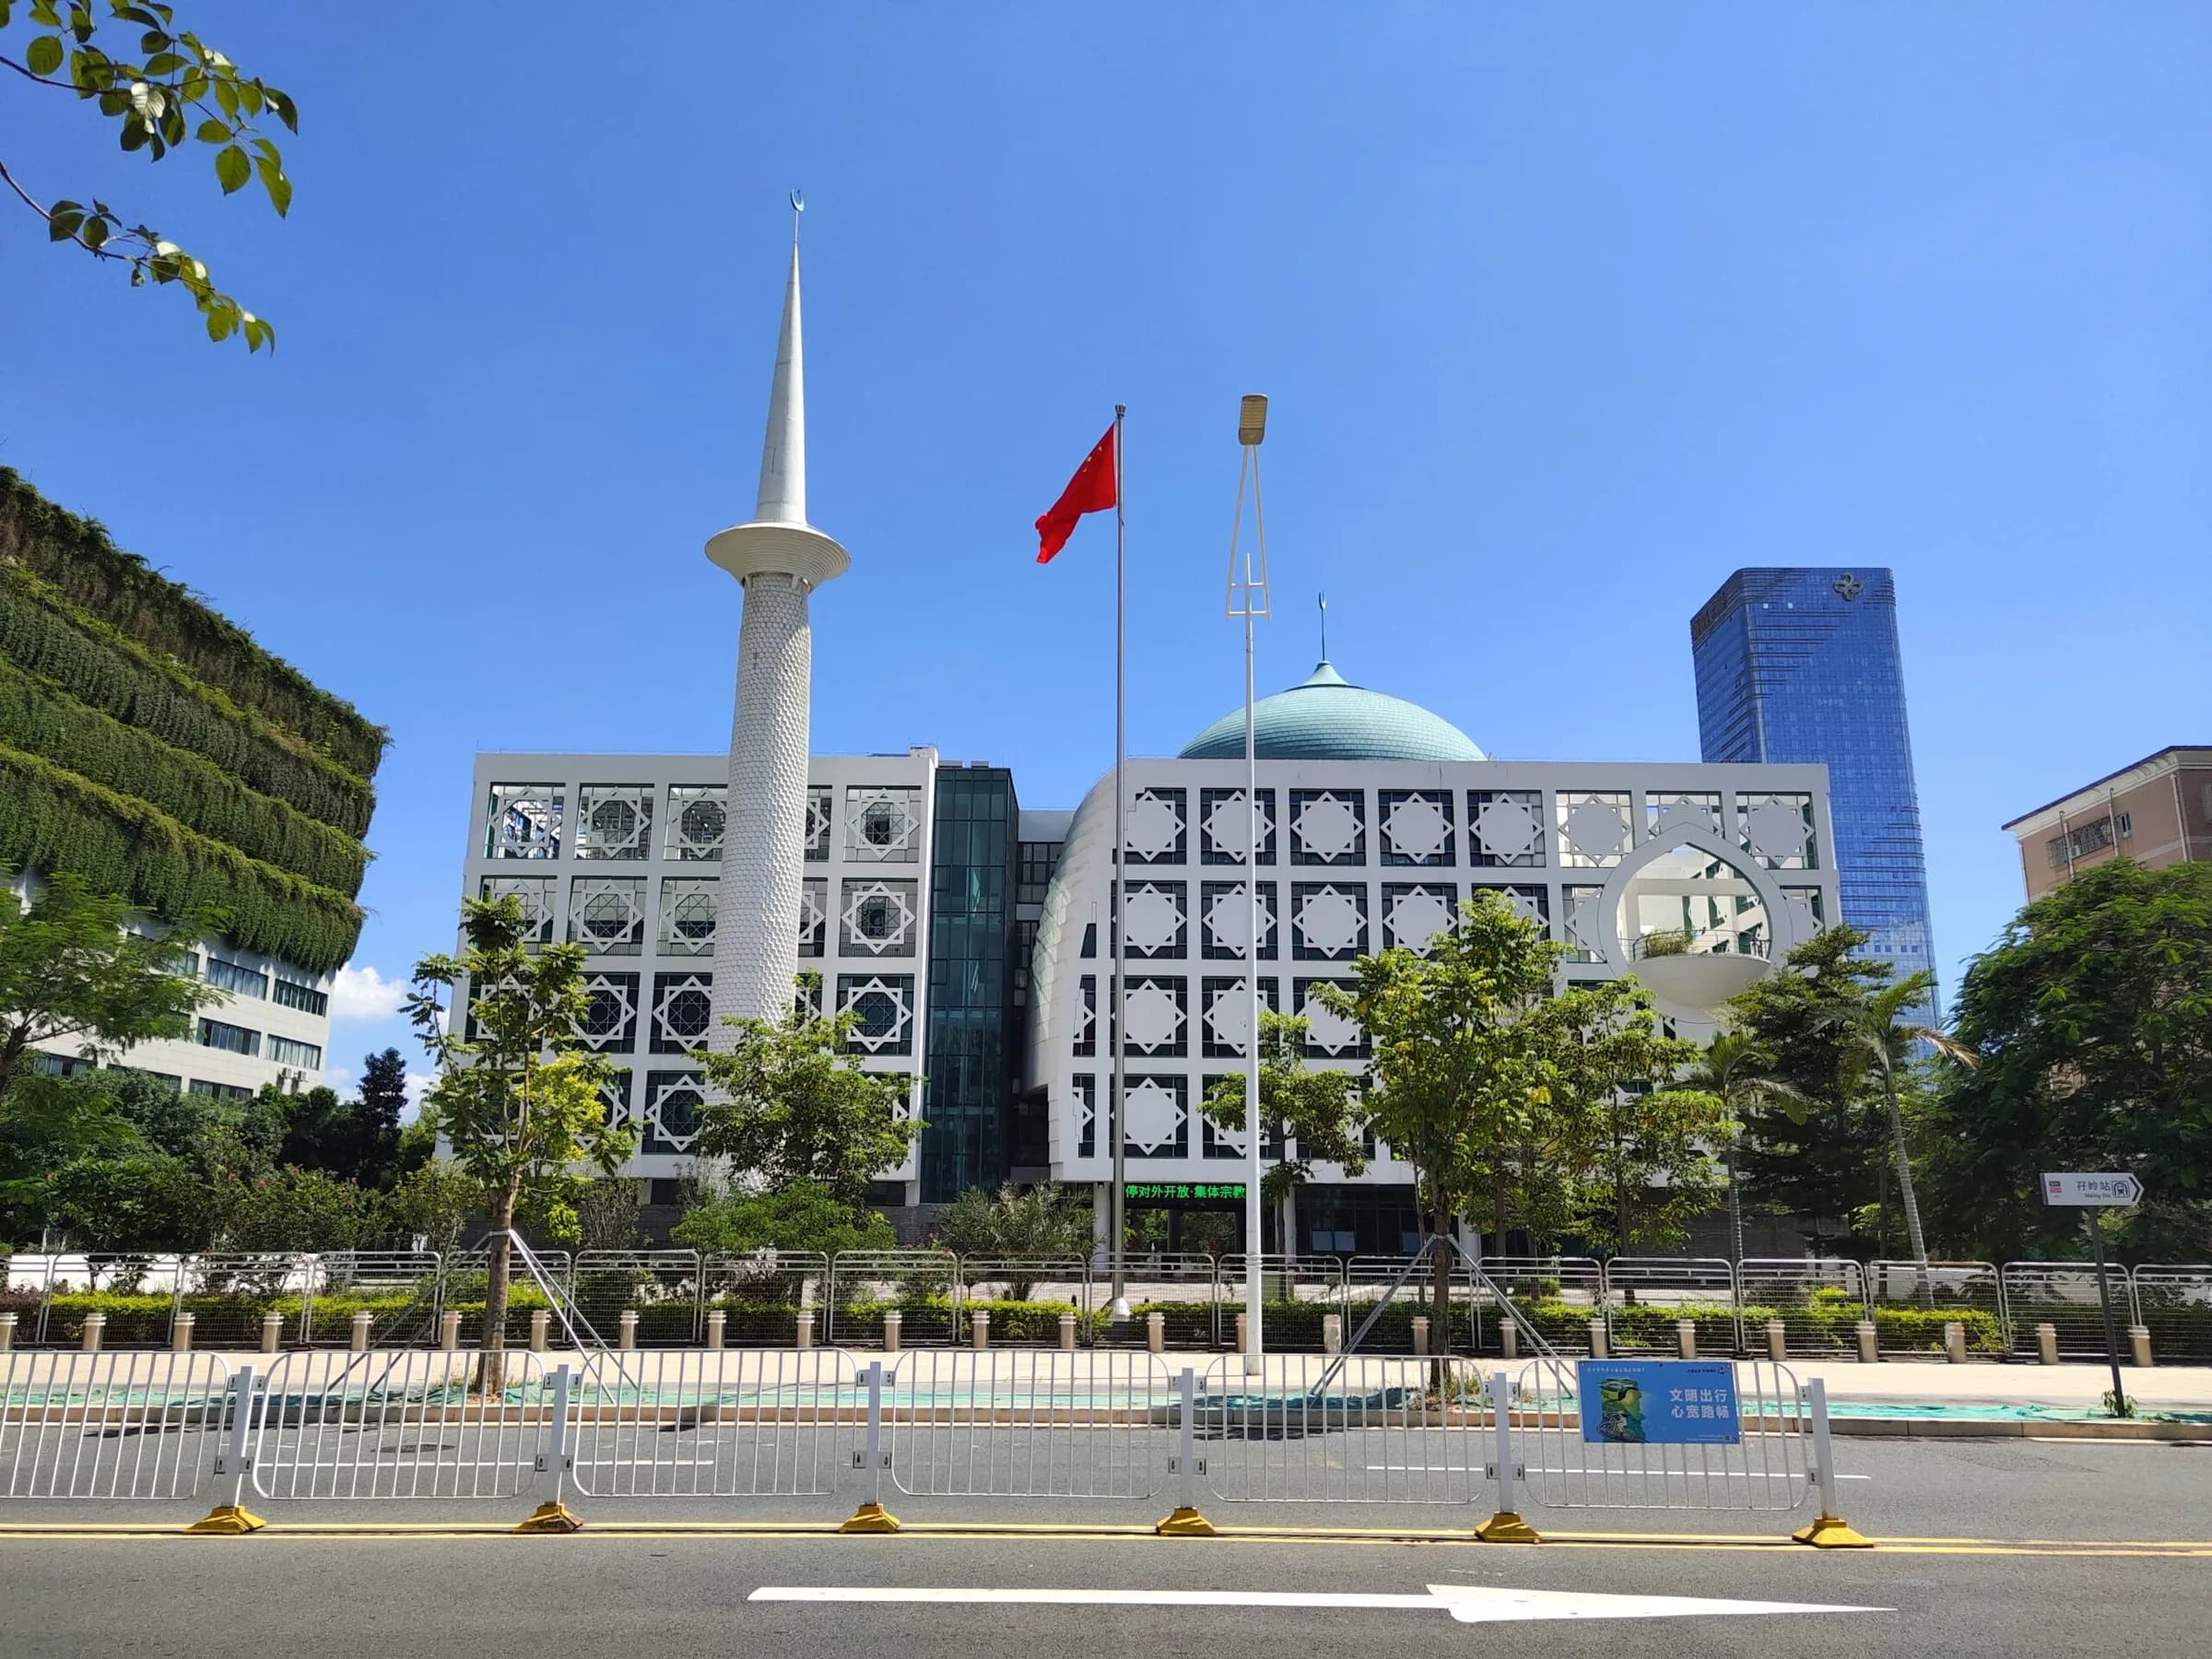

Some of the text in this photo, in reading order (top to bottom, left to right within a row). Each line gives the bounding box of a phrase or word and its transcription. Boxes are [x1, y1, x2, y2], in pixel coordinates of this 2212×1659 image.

[1669, 1388, 1728, 1403] 文明出行
[1671, 1405, 1730, 1419] 心宽路畅
